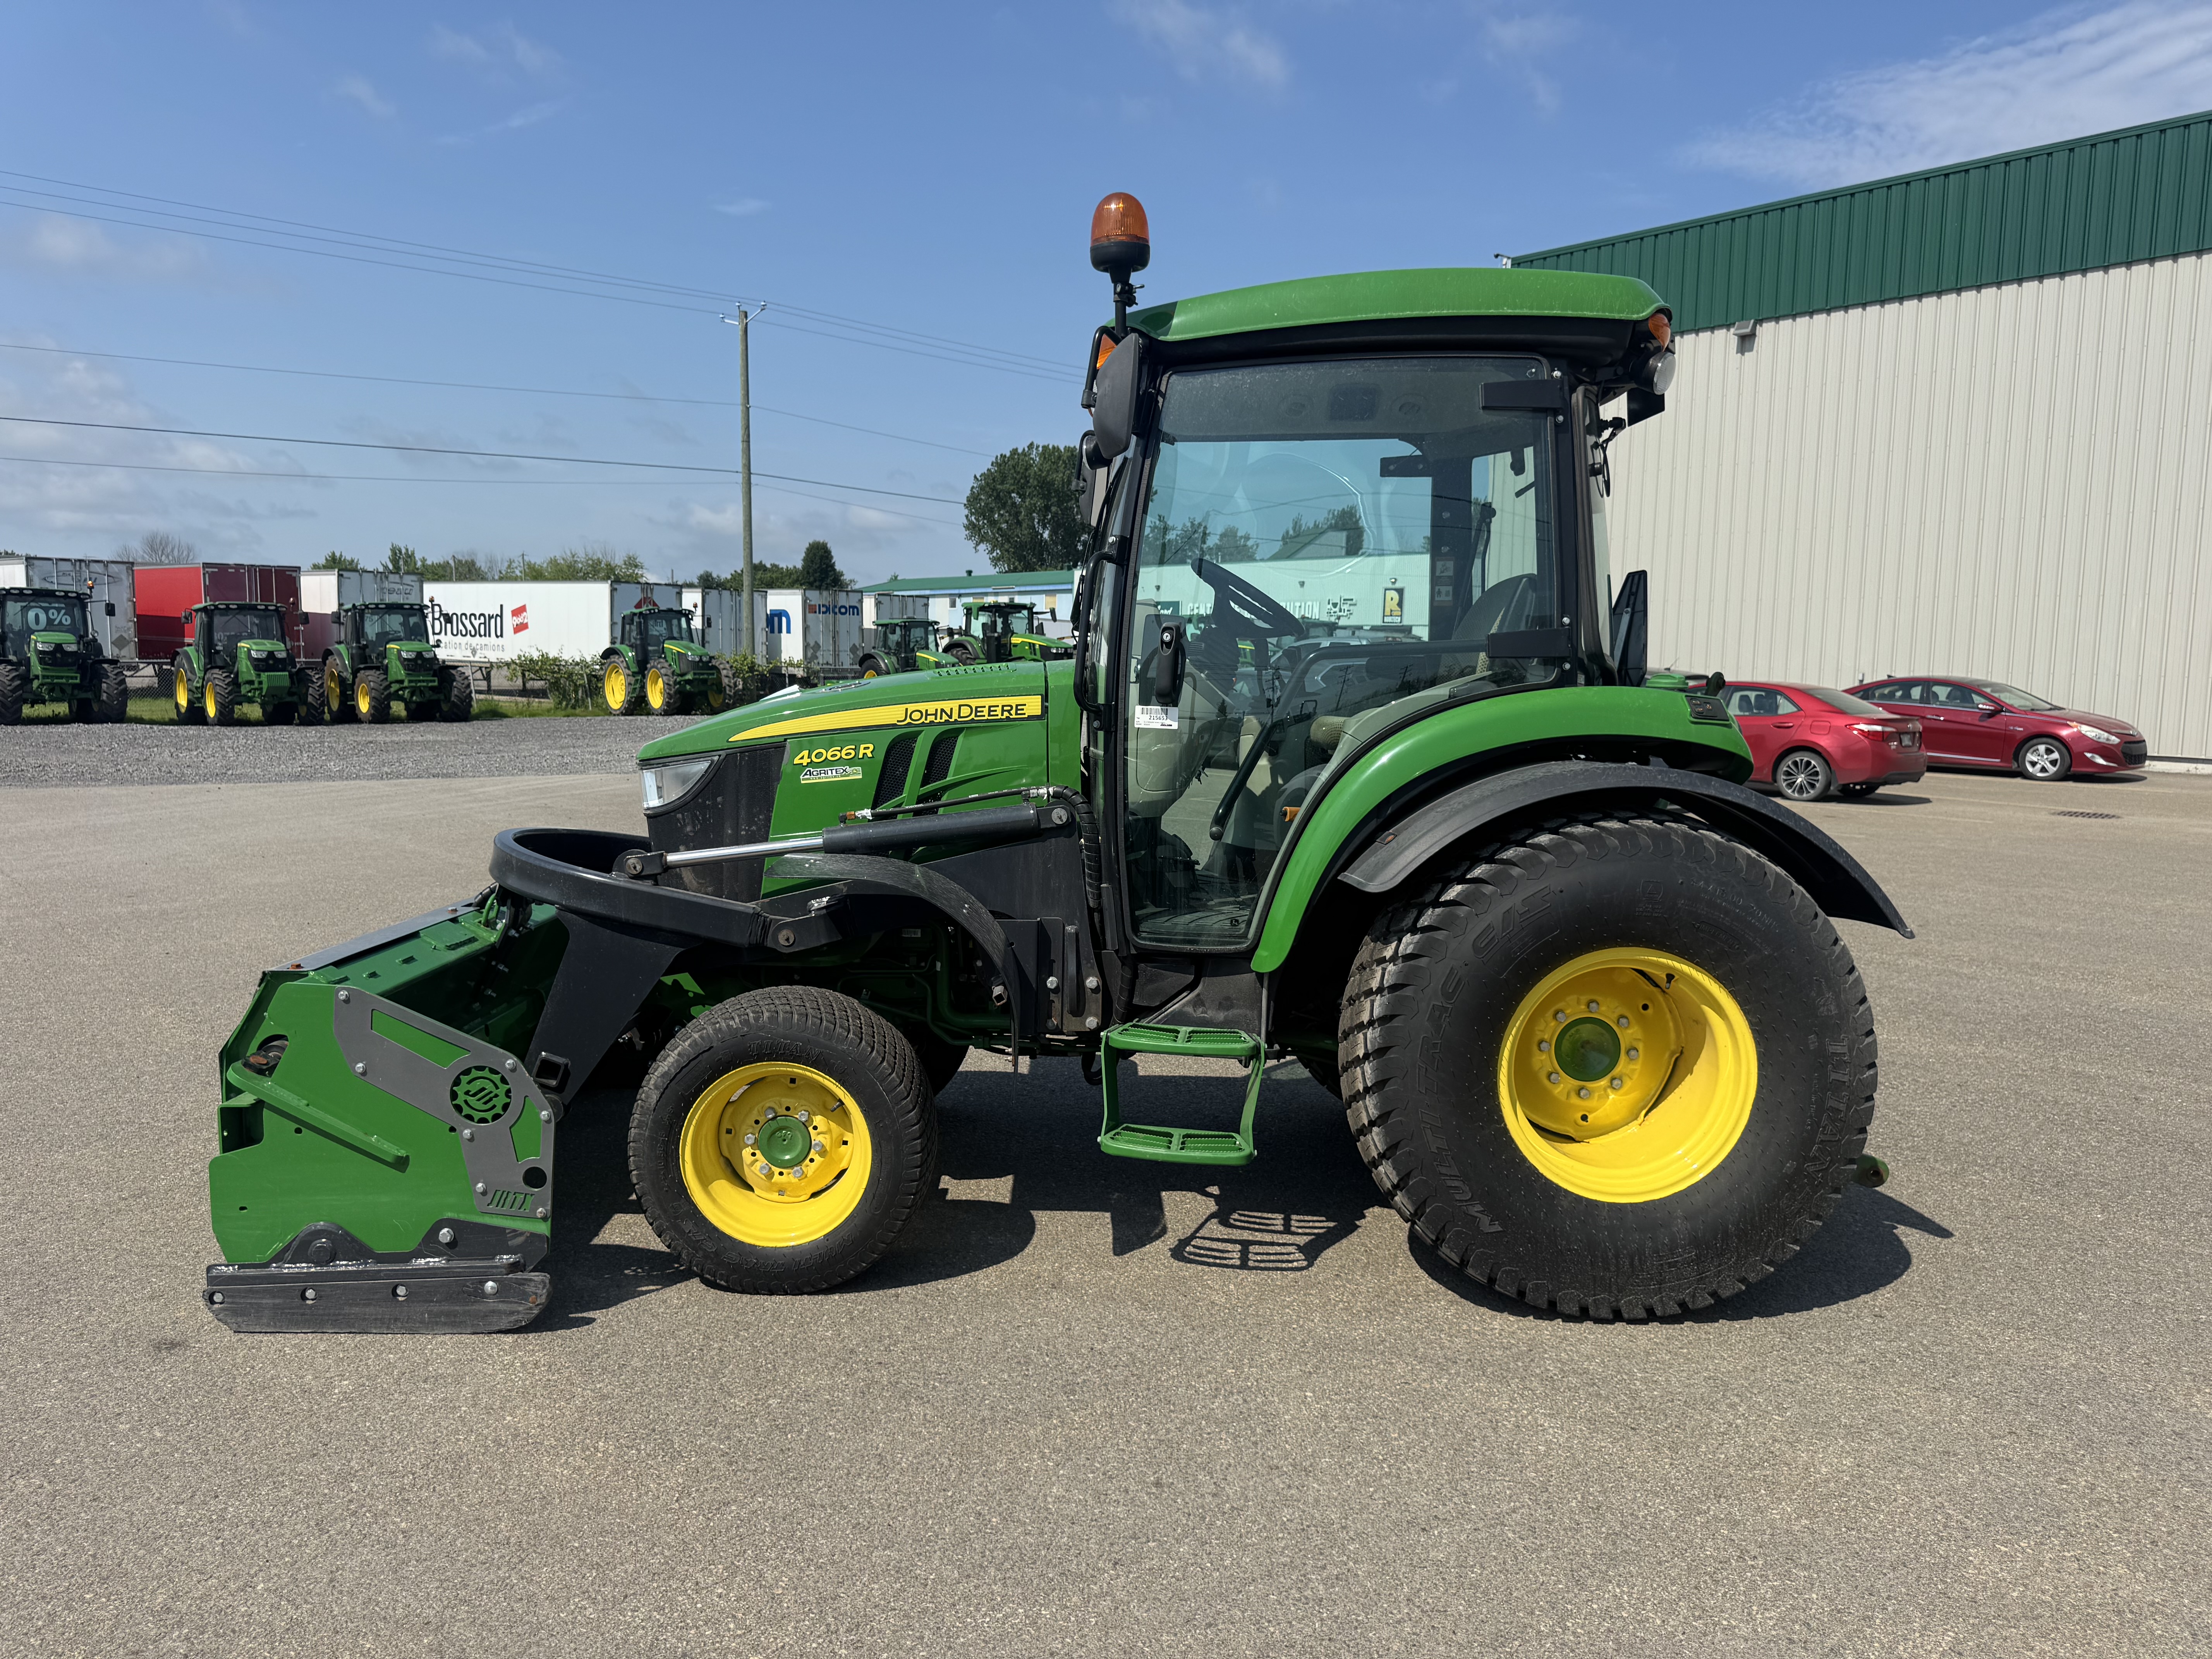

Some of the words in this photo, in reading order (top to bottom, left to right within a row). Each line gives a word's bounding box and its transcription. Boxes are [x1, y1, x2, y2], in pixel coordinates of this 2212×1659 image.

[27, 608, 71, 630] 0%
[1188, 603, 1214, 615] CENT
[432, 604, 503, 638] Brossard
[465, 641, 473, 650] de
[476, 641, 505, 652] camions
[896, 707, 953, 723] JOHN
[958, 703, 1027, 719] DEERE
[802, 767, 848, 777] AGRITEX
[748, 1039, 823, 1060] TITAN
[1804, 1034, 1851, 1185] TITAN
